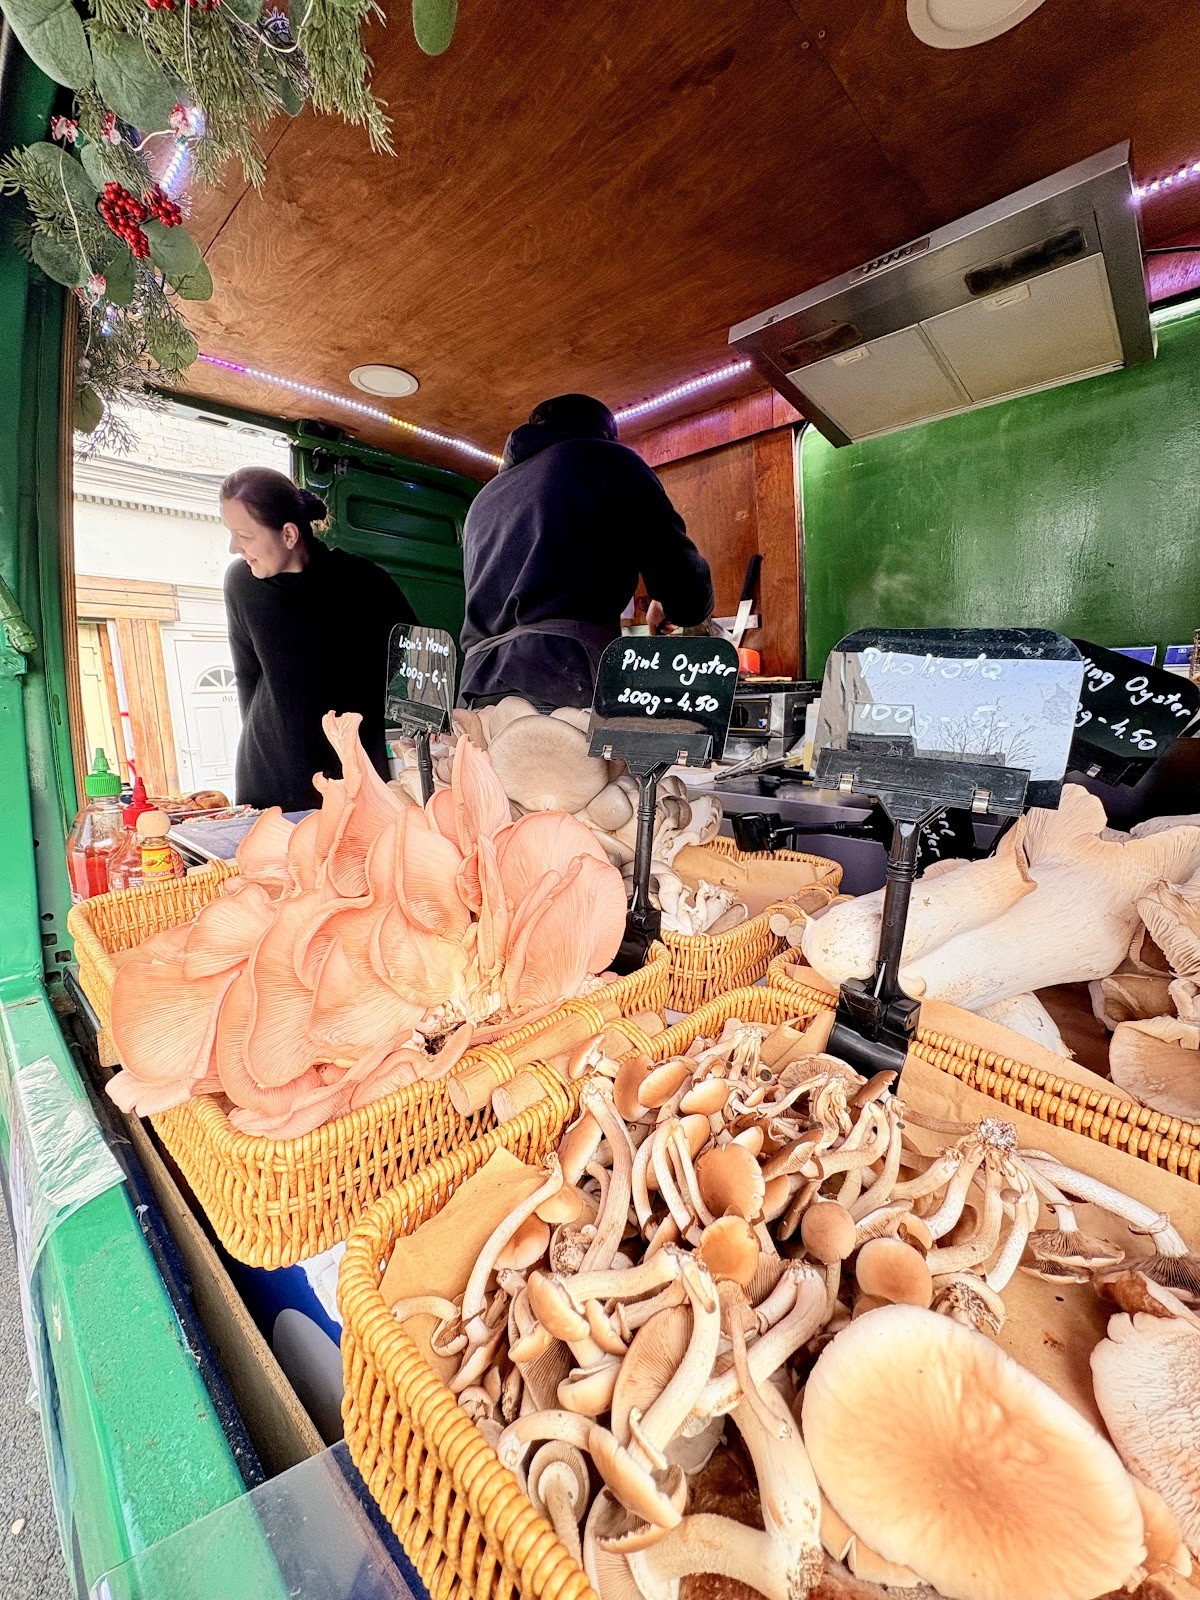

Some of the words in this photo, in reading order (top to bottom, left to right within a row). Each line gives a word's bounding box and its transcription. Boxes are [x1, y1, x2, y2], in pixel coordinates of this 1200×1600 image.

[399, 635, 422, 650] Lion's
[426, 637, 449, 656] Mane
[621, 649, 660, 671] Pink
[672, 654, 737, 685] Oyster
[860, 647, 1002, 680] Pholiota
[1082, 656, 1115, 692] ing
[1125, 676, 1191, 717] Oyster
